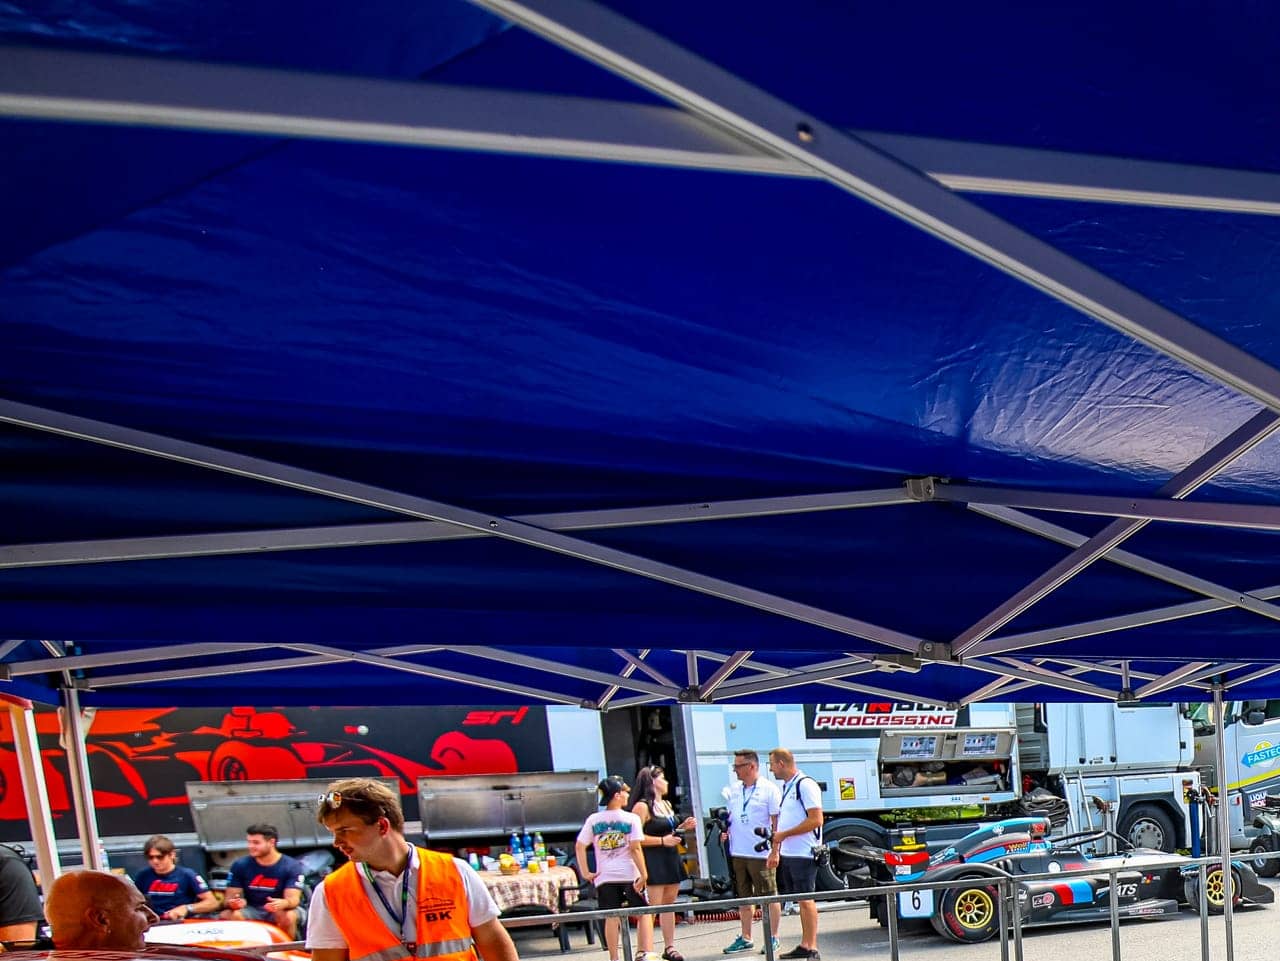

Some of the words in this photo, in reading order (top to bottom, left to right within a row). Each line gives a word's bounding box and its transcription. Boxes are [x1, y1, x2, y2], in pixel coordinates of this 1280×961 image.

[816, 714, 956, 727] PROCESSING
[1247, 745, 1280, 764] FASTEC
[912, 890, 921, 910] 6
